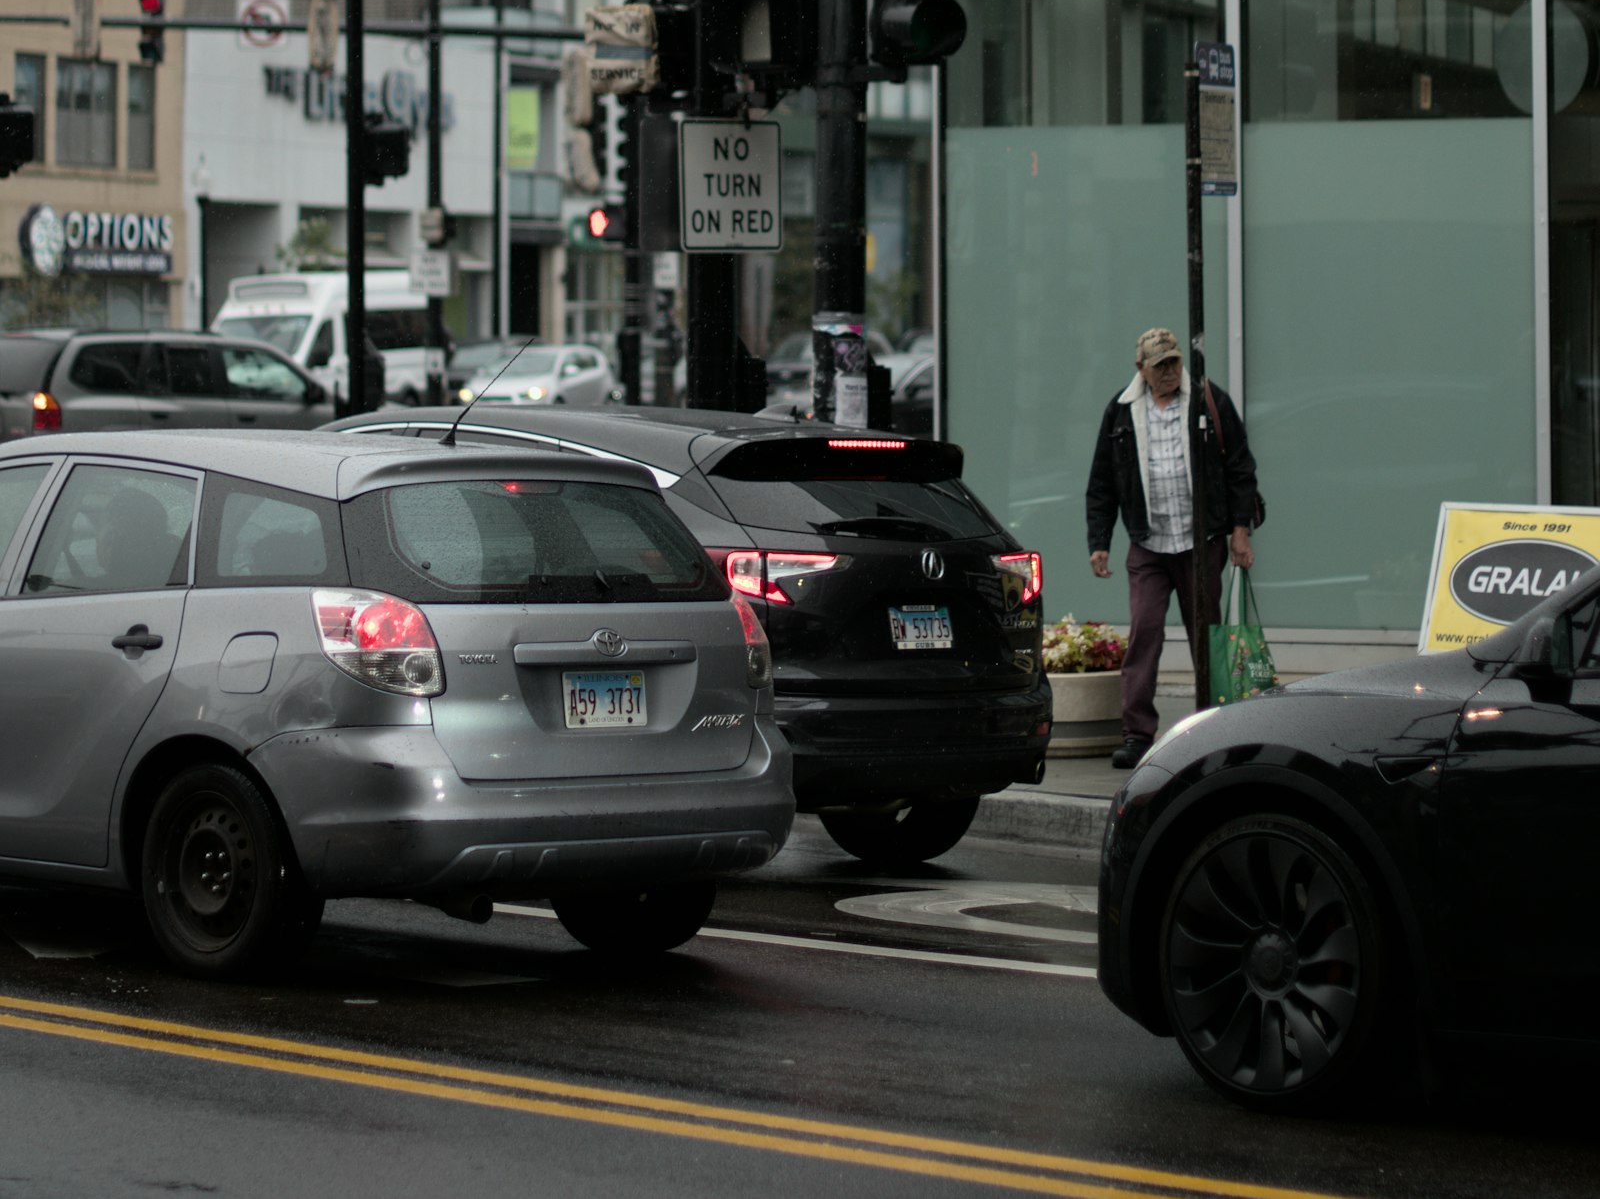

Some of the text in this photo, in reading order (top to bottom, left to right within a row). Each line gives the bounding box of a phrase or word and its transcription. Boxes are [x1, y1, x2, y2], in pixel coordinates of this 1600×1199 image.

[1219, 49, 1232, 65] bus
[1219, 66, 1234, 82] stop
[713, 137, 750, 161] NO
[703, 173, 761, 197] TURN
[66, 211, 174, 251] OPTIONS
[691, 210, 774, 233] ON RED
[1502, 521, 1572, 533] Since 1991
[912, 617, 950, 639] 53735
[459, 654, 499, 665] TOYOTA
[584, 674, 624, 682] ILLINOIS
[570, 687, 642, 716] A59 3737
